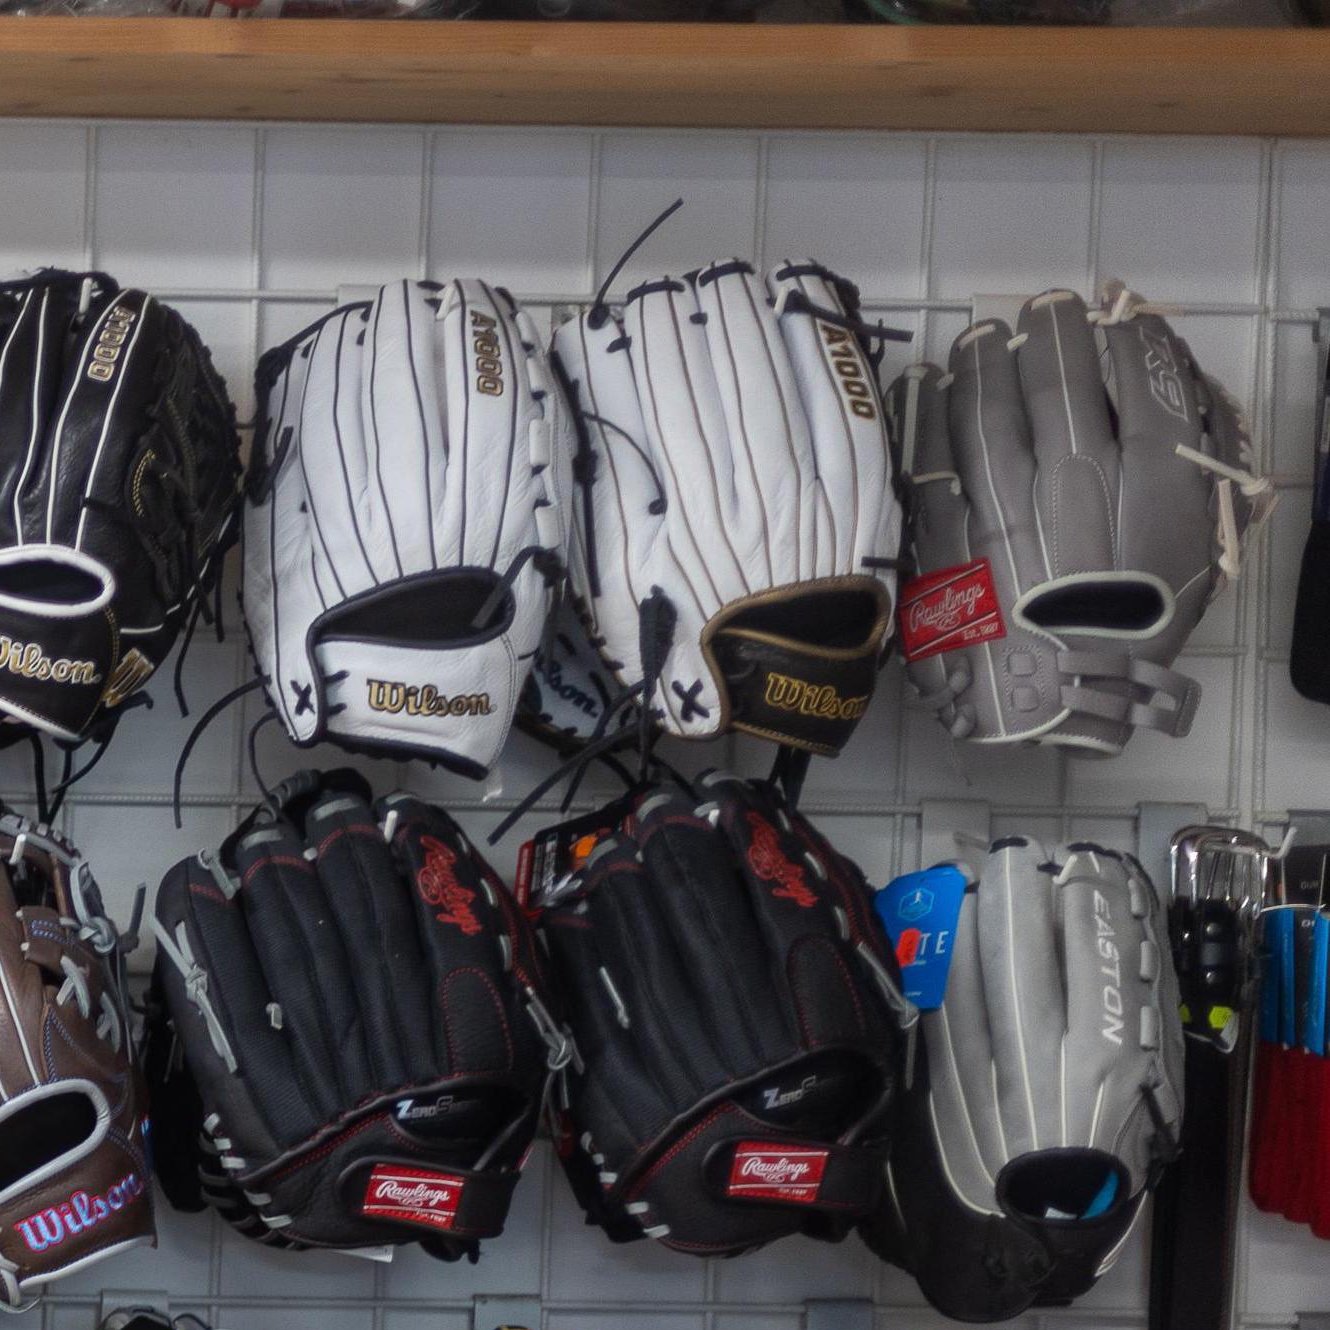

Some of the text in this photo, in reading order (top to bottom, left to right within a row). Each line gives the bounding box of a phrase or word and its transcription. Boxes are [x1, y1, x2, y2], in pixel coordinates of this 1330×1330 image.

[471, 310, 504, 397] A1000
[821, 322, 876, 421] A1000
[910, 583, 987, 632] Rawlings
[366, 678, 491, 717] Wilson
[1092, 889, 1125, 1045] EASTON
[375, 1180, 450, 1206] Rawlings
[742, 1157, 810, 1181] Rawlings
[14, 1171, 145, 1253] Wilson
